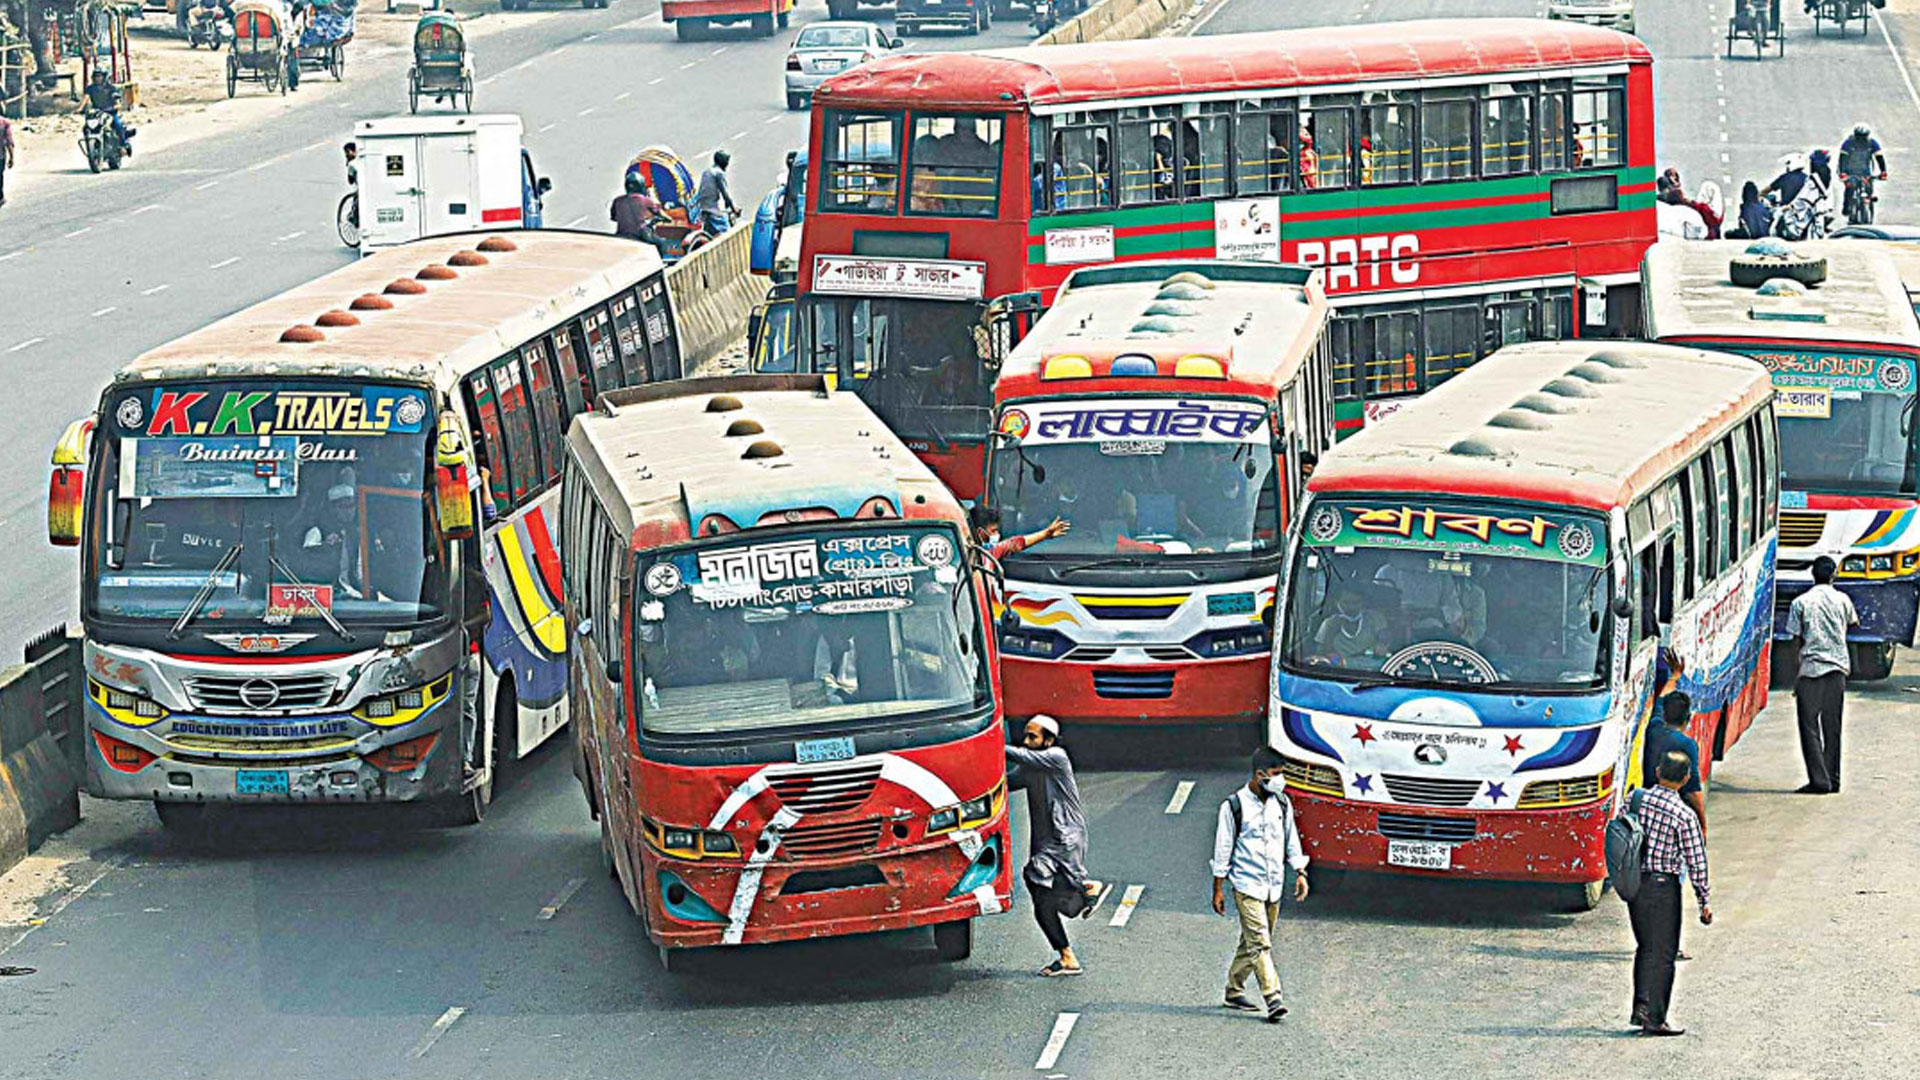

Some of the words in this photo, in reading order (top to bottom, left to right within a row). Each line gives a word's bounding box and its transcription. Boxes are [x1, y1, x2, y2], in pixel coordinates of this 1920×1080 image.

[179, 442, 287, 462] Business
[295, 441, 358, 462] Class
[1344, 505, 1560, 547] শ্রাবণ
[172, 721, 242, 737] EDUCATION
[245, 725, 269, 738] FOR
[272, 724, 317, 737] HUMAN
[319, 721, 348, 734] LIFE
